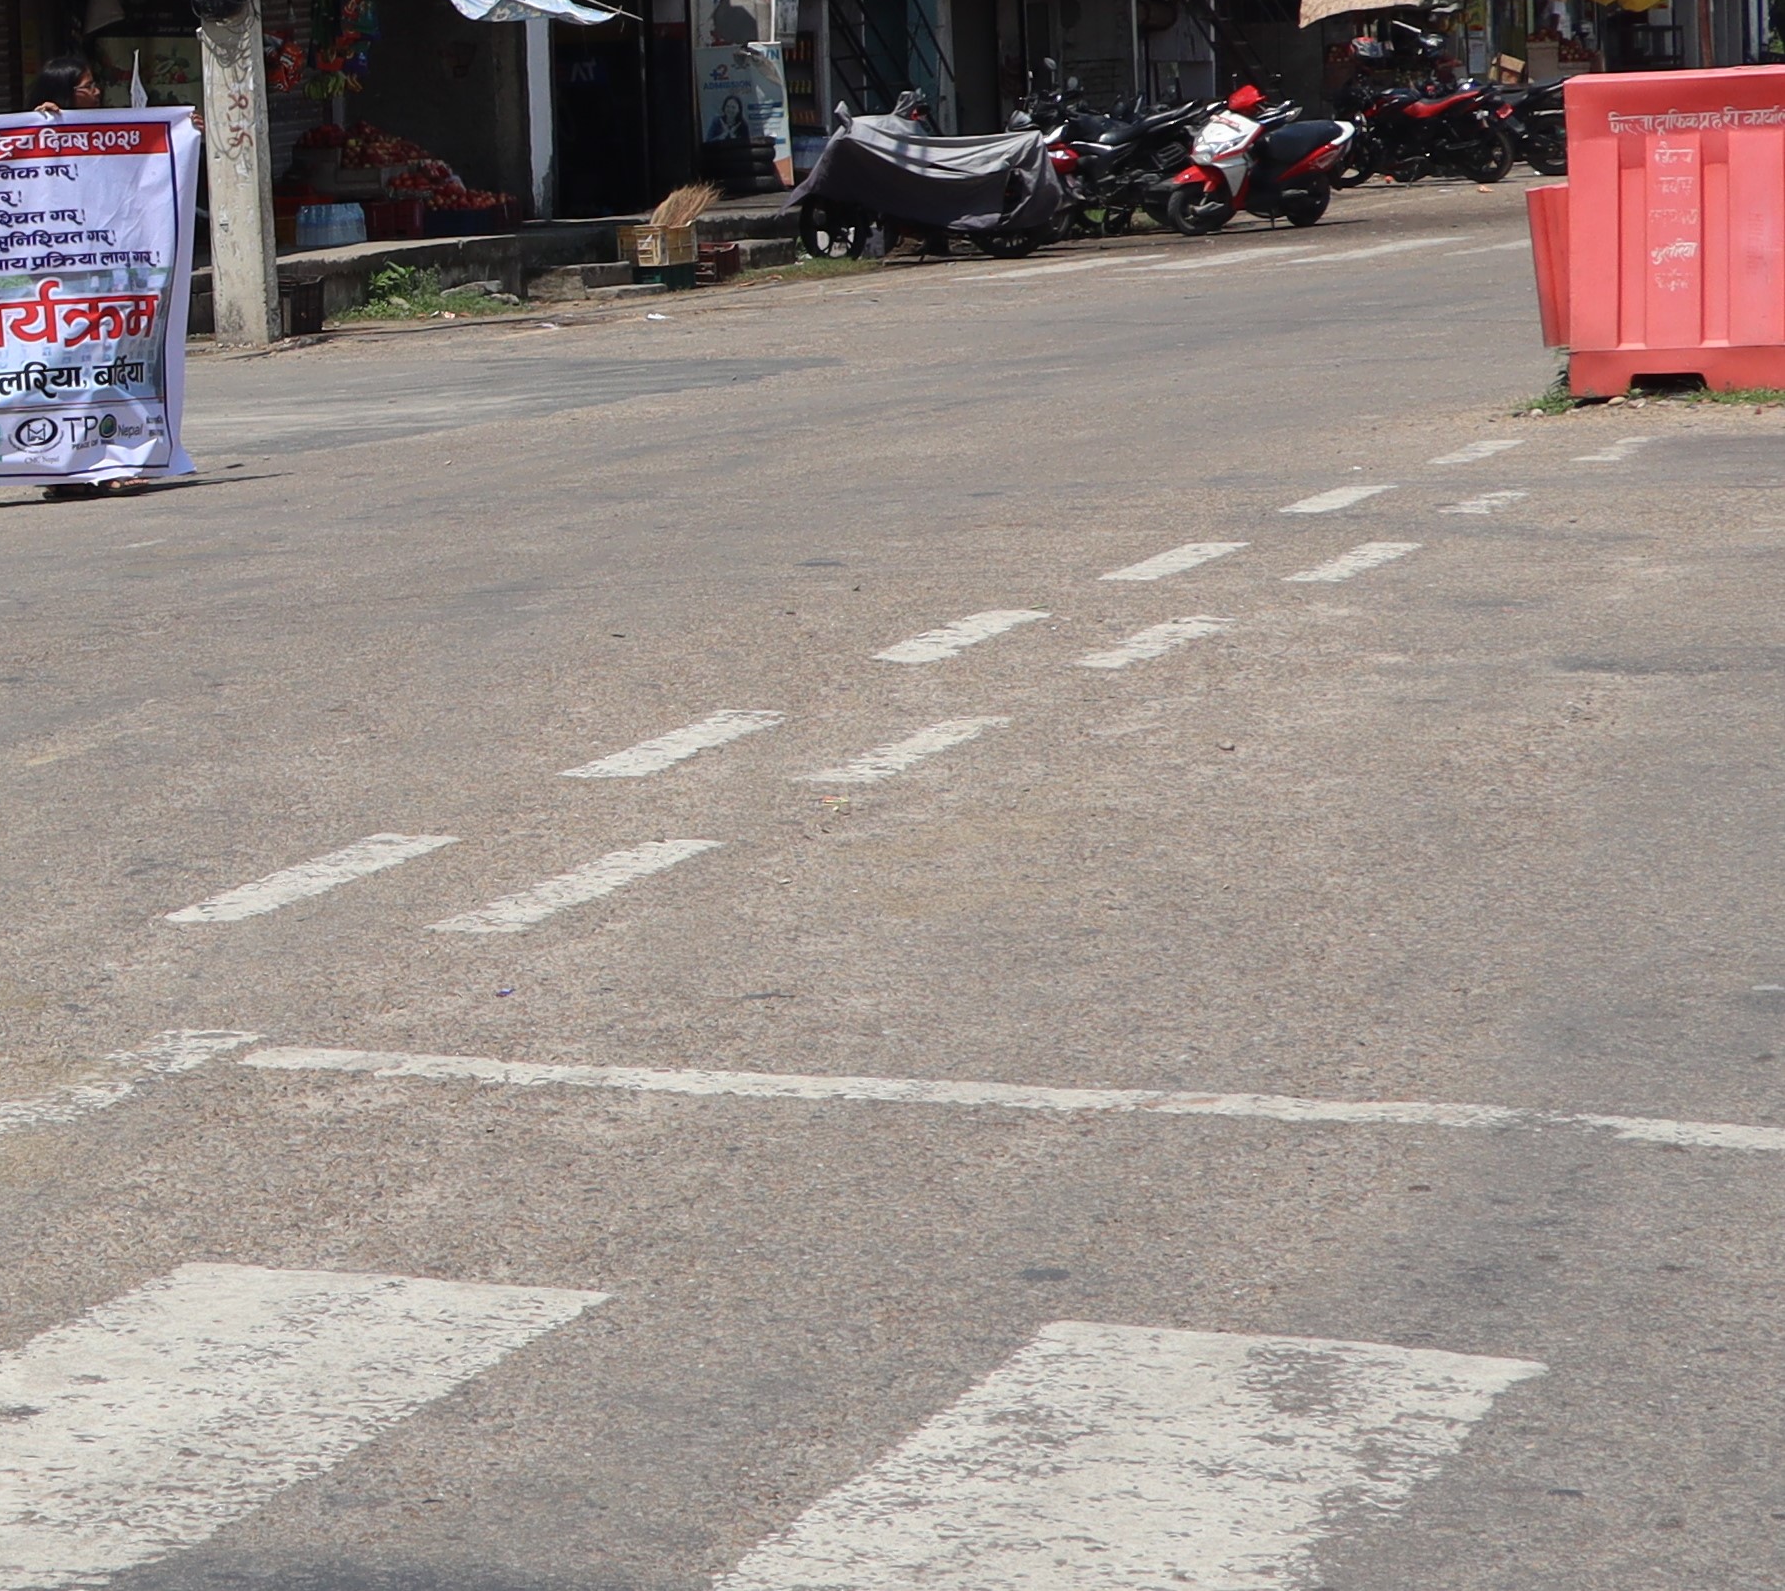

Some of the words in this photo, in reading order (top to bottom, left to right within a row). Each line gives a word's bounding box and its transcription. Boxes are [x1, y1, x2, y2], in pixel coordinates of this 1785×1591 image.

[710, 63, 729, 80] +2
[702, 79, 752, 91] ADMISSION
[38, 127, 91, 153] दिवस
[92, 129, 141, 152] २०२४
[29, 251, 97, 272] प्रक्रिया
[92, 354, 145, 392] बर्दिया
[117, 422, 145, 441] Nepal
